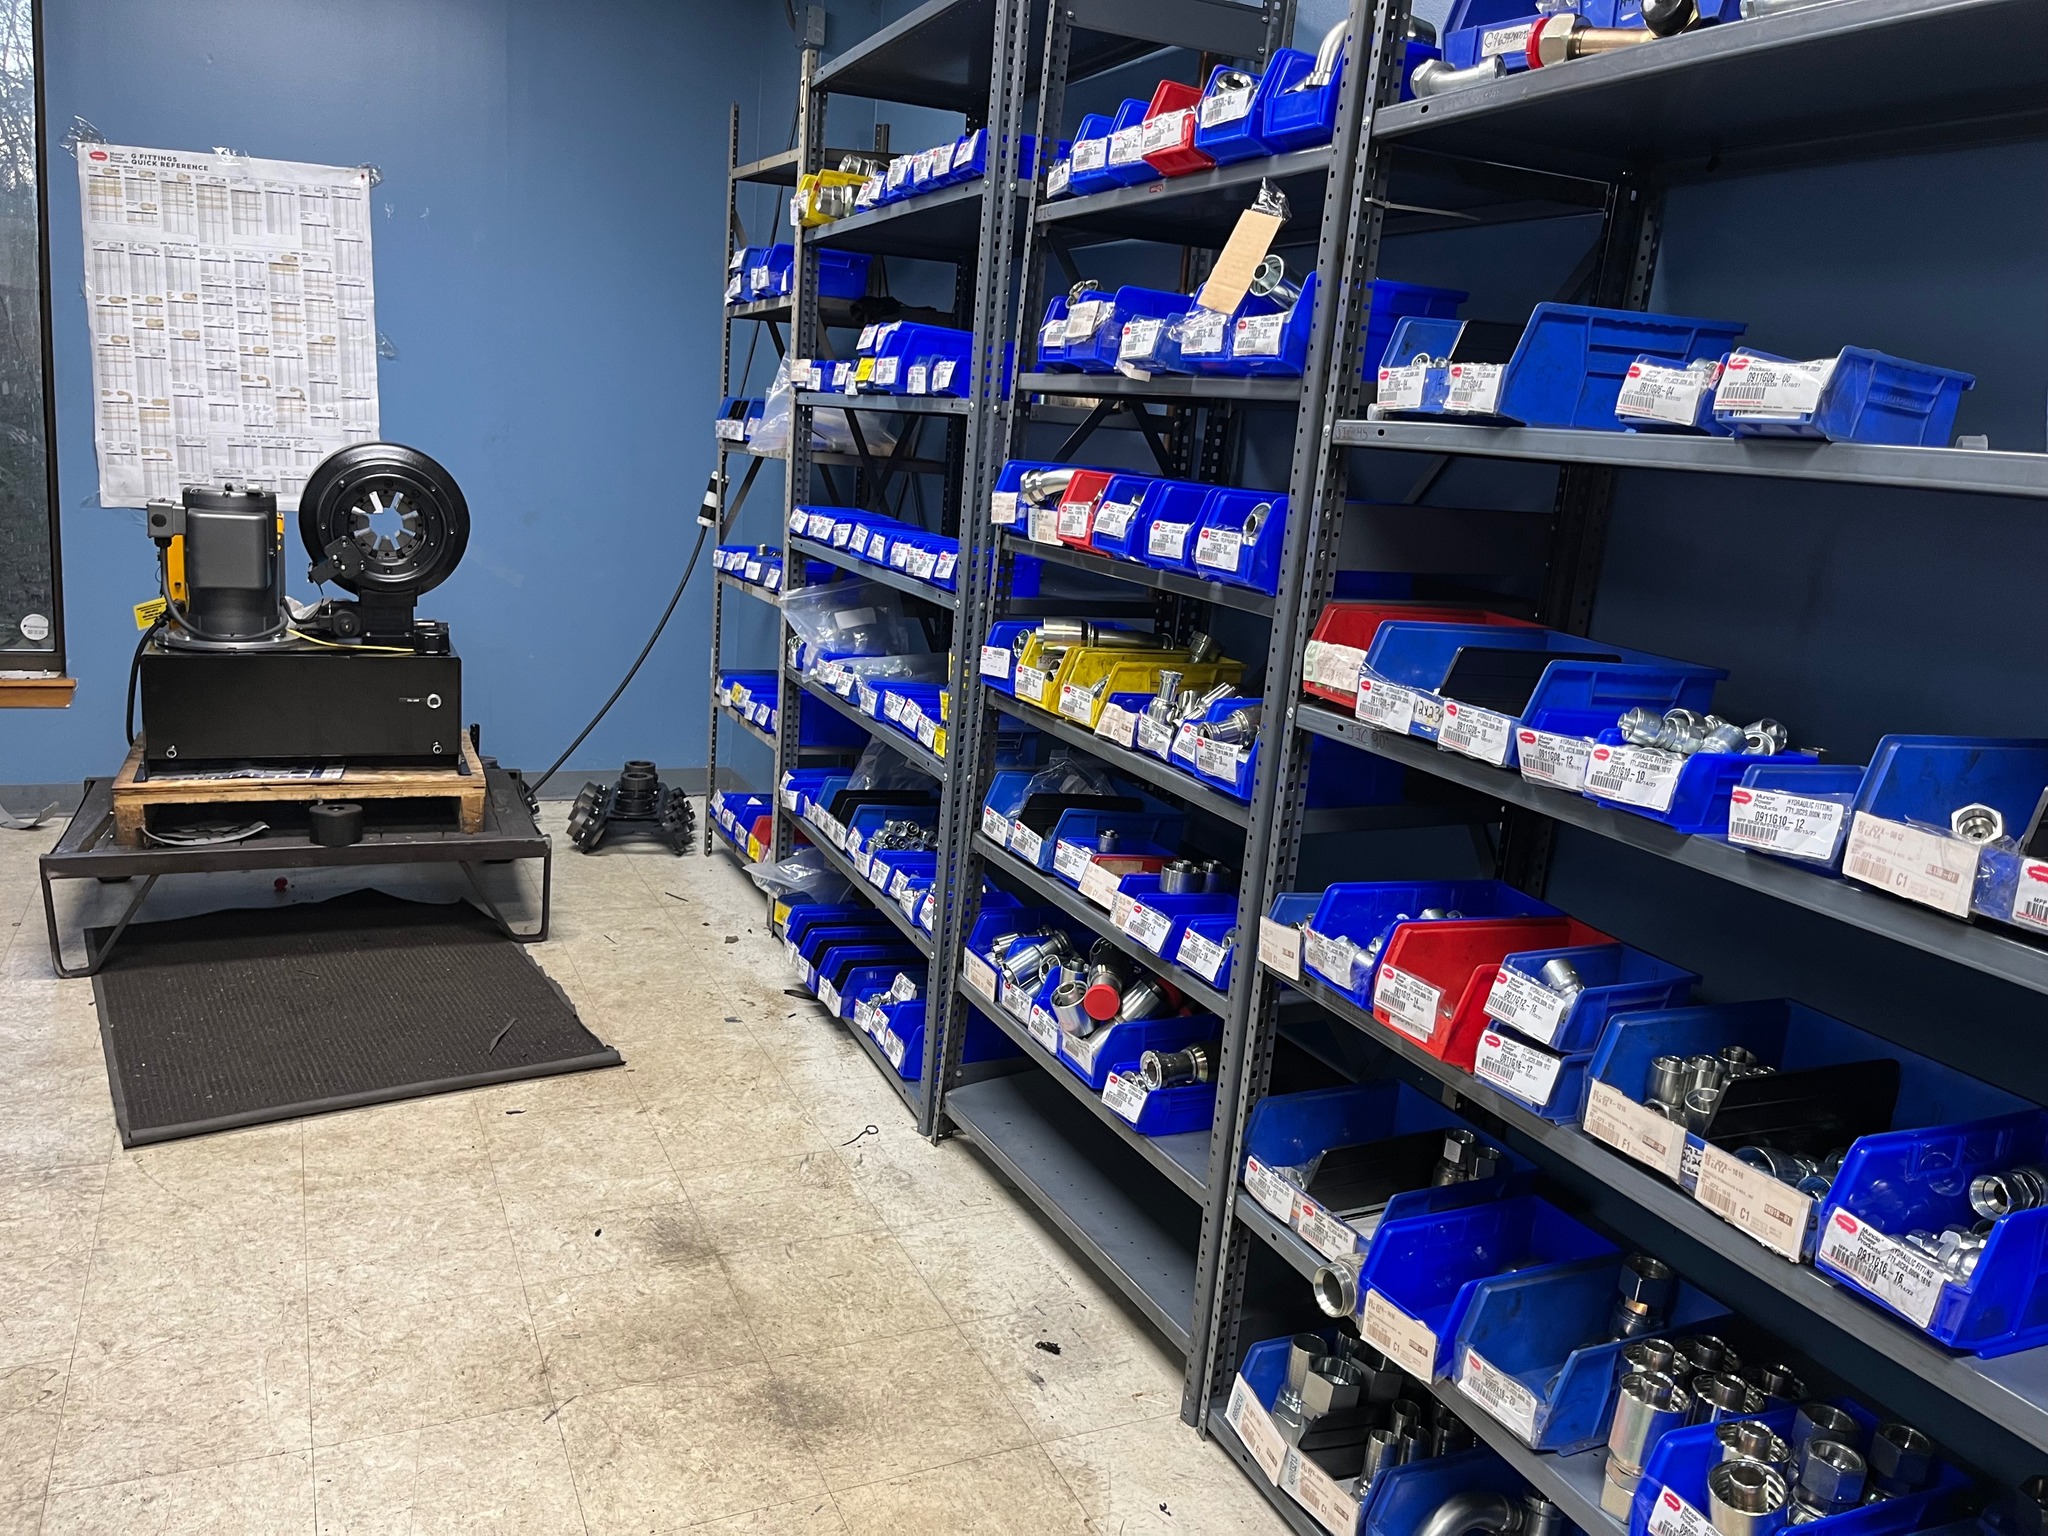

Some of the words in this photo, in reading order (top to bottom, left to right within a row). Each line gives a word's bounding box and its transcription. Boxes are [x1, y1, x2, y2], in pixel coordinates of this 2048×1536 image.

[131, 159, 158, 167] QUICK
[160, 162, 209, 171] REFERENCE
[140, 154, 178, 163] FITTINGS
[1747, 372, 1792, 384] 0911G08-06
[1347, 724, 1368, 744] JIC
[1538, 743, 1555, 751] Products
[1539, 749, 1574, 765] 0911G08-12
[1633, 753, 1654, 762] HYDRAULIC
[1609, 764, 1645, 781] 0911G10-10
[1756, 793, 1776, 801] Muncie
[1753, 803, 1778, 812] Products
[1787, 799, 1815, 809] HYDRAULIC
[1815, 802, 1833, 812] FITTING
[1755, 811, 1805, 829] 0911G10-12
[1896, 872, 1908, 887] C1
[2033, 897, 2047, 905] MPP
[1511, 977, 1524, 986] Muncie
[1507, 984, 1523, 995] Products
[1504, 990, 1537, 1013] 0911G12-16
[1502, 1044, 1514, 1052] Power
[1503, 1040, 1518, 1049] Muncie
[1501, 1048, 1518, 1058] Products
[1500, 1053, 1533, 1074] 0911G16-12
[1621, 1138, 1630, 1152] F1
[1740, 1207, 1750, 1222] C1
[1860, 1232, 1876, 1246] Power
[1862, 1227, 1880, 1243] Muncie
[1858, 1236, 1880, 1254] Products
[1857, 1247, 1904, 1283] 0911G16-16
[1891, 1248, 1915, 1266] HYDRAULIC
[1915, 1261, 1934, 1278] FITTING
[1682, 1510, 1695, 1523] Power
[1684, 1506, 1699, 1521] Muncie
[1680, 1514, 1699, 1533] Products
